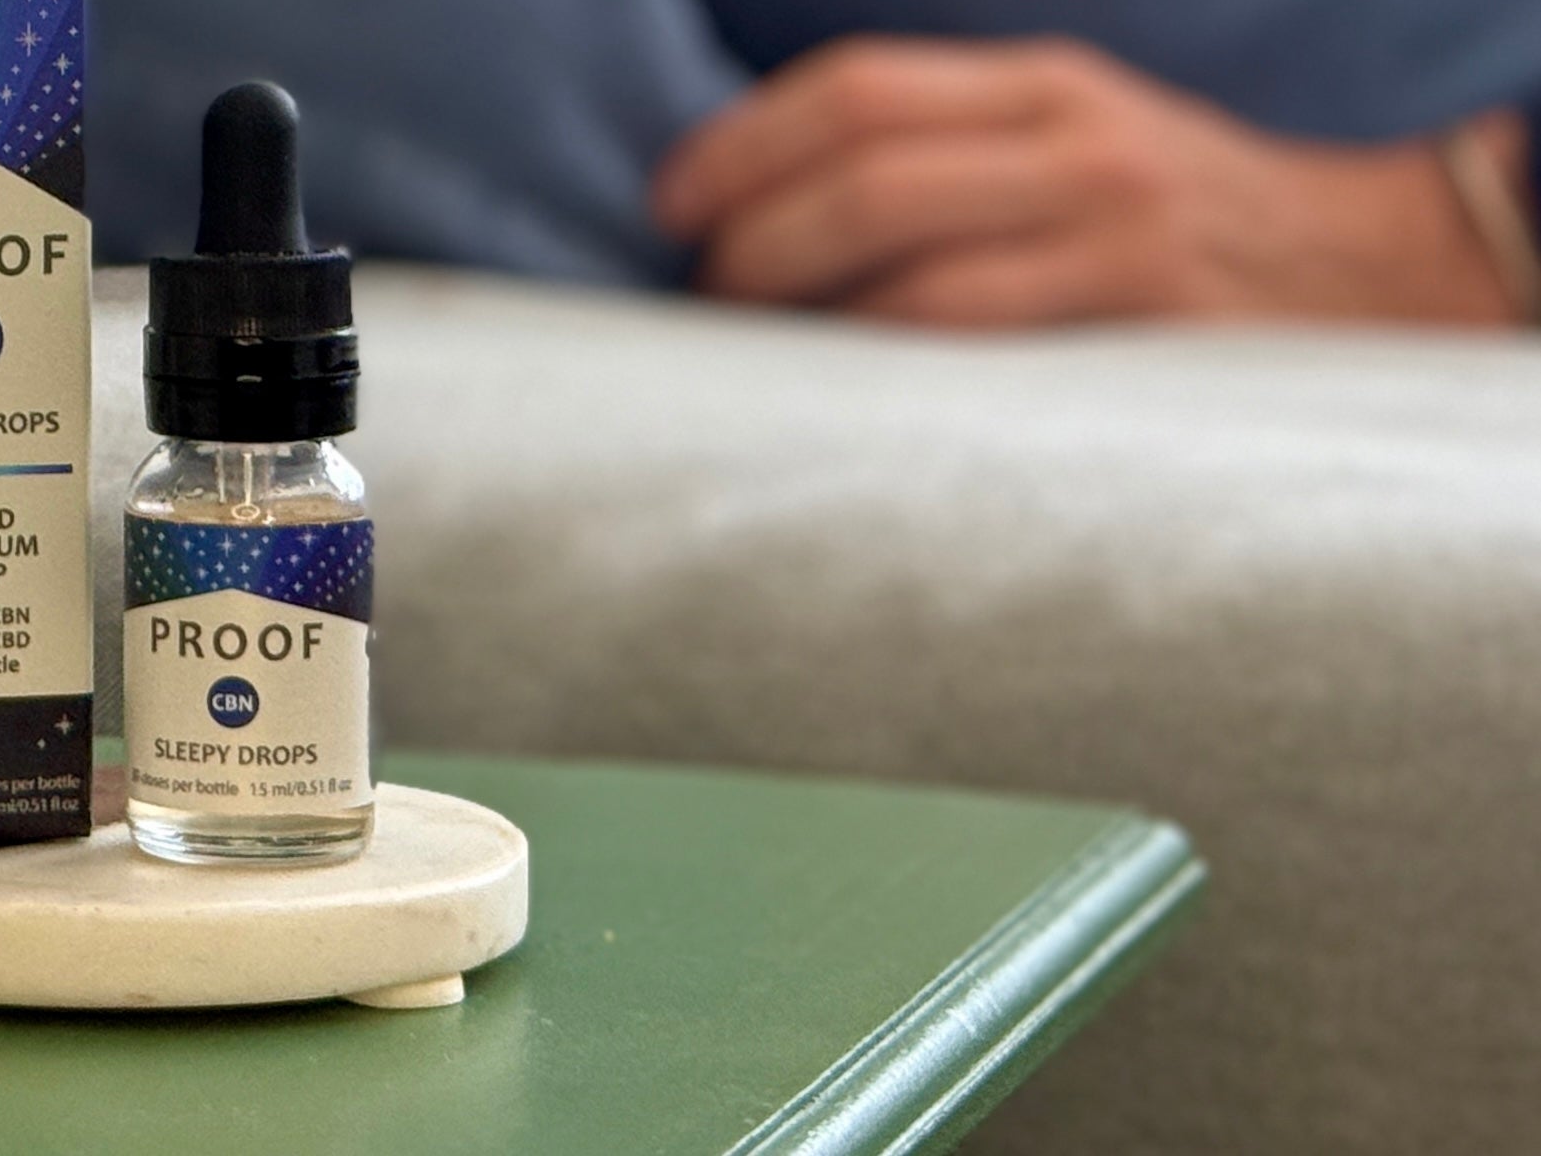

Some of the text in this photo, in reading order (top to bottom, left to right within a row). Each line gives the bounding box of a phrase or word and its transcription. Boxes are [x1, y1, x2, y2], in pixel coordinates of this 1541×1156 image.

[150, 617, 324, 661] PROOF
[211, 692, 254, 712] CBN
[154, 738, 318, 766] SLEEPY DROPS
[11, 778, 35, 795] per
[37, 774, 80, 790] bottle
[172, 778, 193, 793] per
[195, 778, 239, 795] bottle
[250, 782, 267, 797] 15
